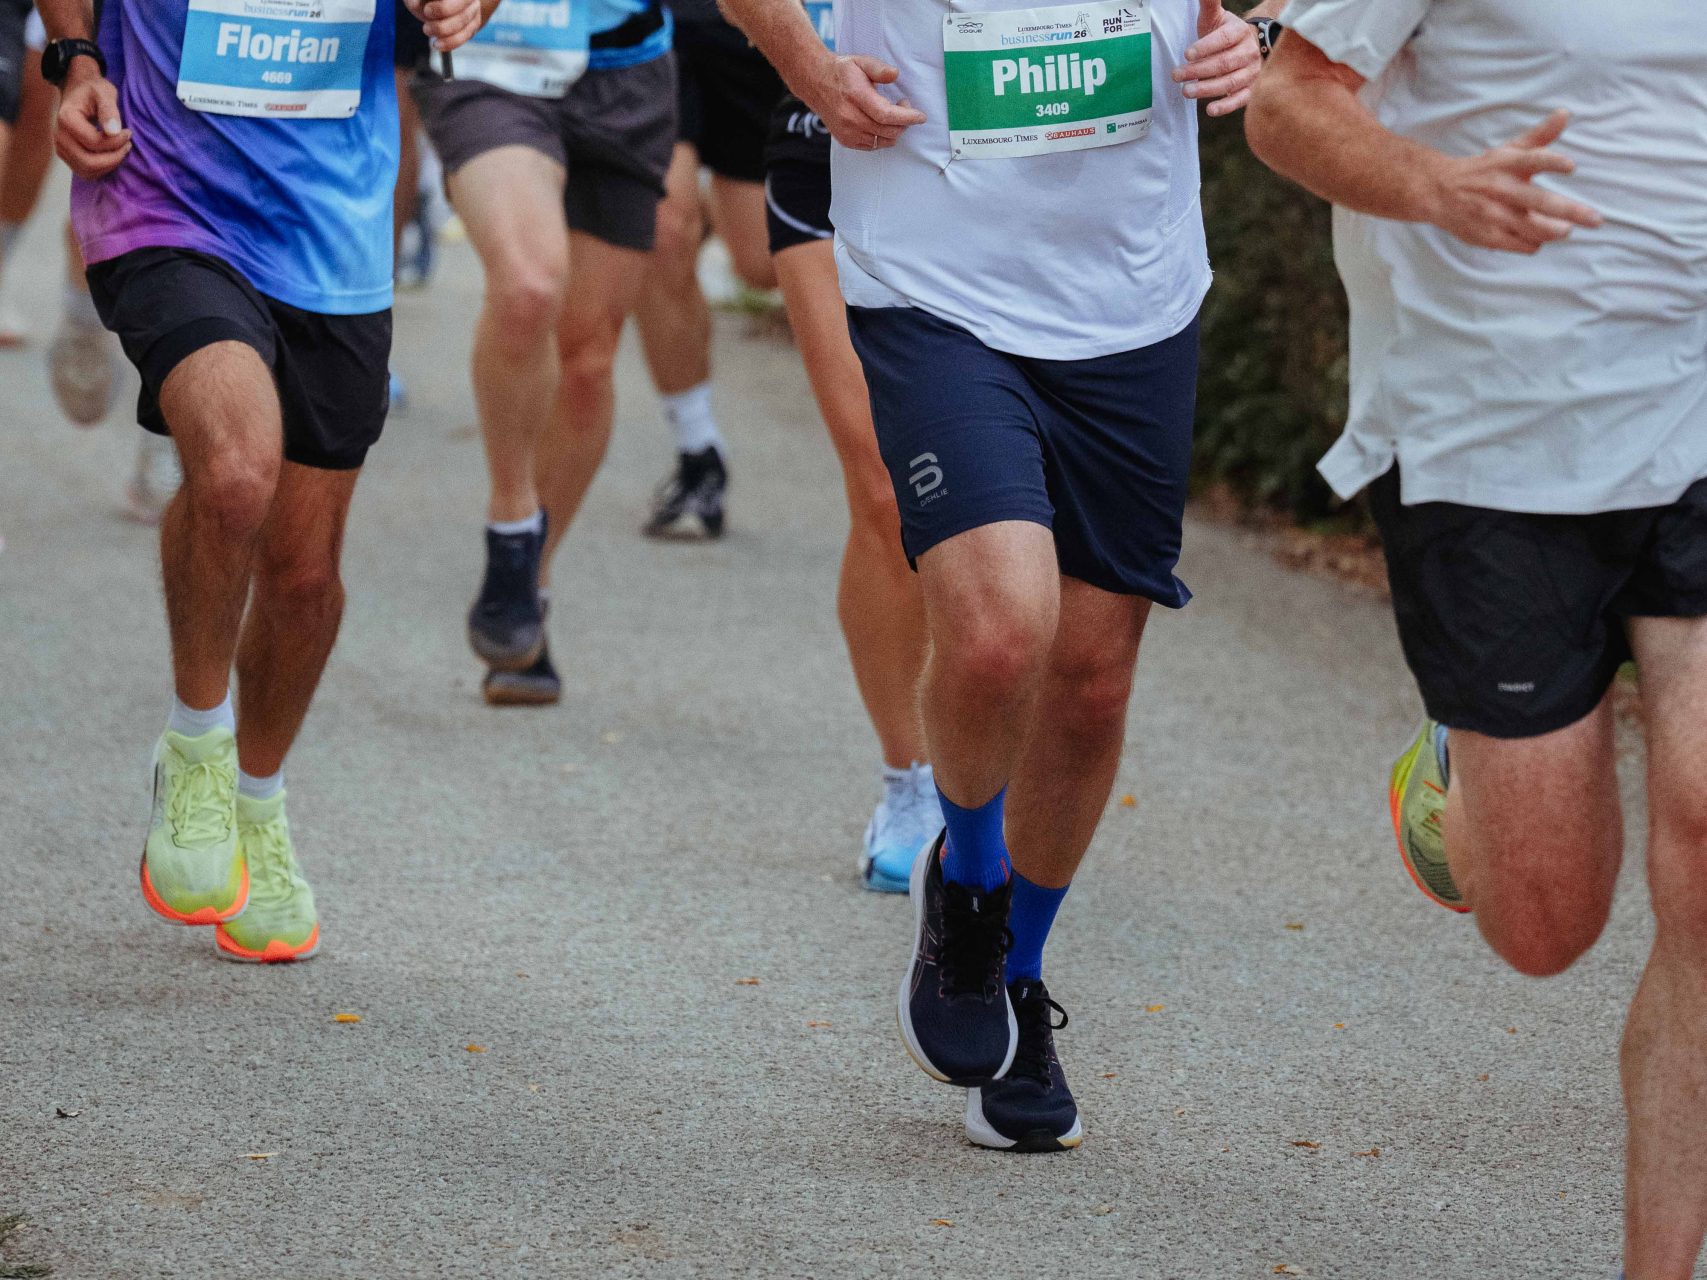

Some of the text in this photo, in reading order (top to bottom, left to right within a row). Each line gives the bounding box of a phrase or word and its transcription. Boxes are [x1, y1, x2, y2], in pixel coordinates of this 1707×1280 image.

[309, 10, 321, 19] 26
[1103, 17, 1122, 27] RUN
[1073, 30, 1087, 39] 26
[1104, 25, 1123, 34] FOR
[216, 22, 340, 63] Florian
[992, 52, 1107, 96] Philip
[1035, 102, 1070, 117] 3409
[1053, 127, 1095, 139] BAUHAUS
[1014, 134, 1038, 143] TIMES
